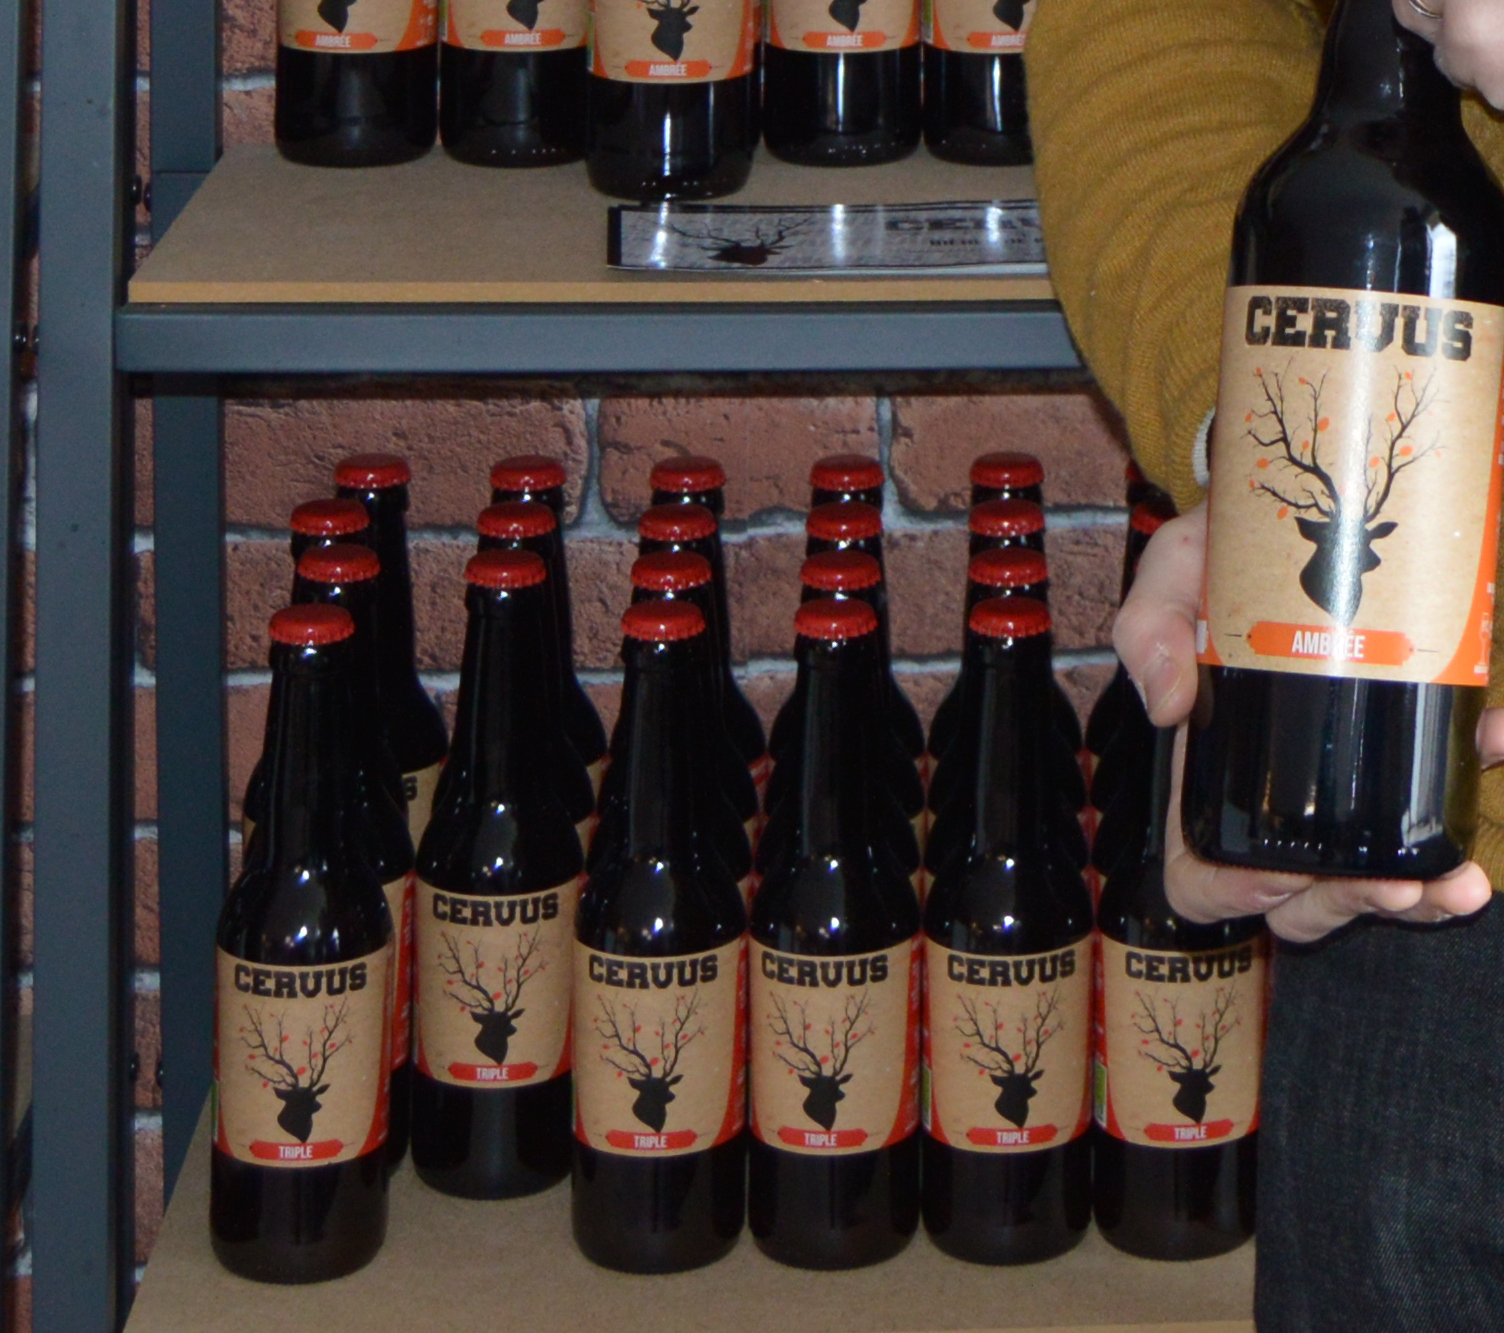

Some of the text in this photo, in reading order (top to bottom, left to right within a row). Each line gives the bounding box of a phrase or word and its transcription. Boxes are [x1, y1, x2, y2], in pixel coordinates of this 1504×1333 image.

[1244, 295, 1474, 362] CERVUS
[432, 891, 559, 928] CERVUS
[234, 962, 368, 999] CERVUS
[588, 952, 719, 990] CERVUS
[761, 950, 889, 989] CERVUS
[946, 950, 1077, 988] CERVUS
[1124, 946, 1253, 985] CERVUS
[475, 1065, 509, 1081] TRIPLE
[633, 1132, 668, 1149] TRIPLE
[803, 1130, 838, 1147] TRIPLE
[996, 1129, 1030, 1145] TRIPLE
[1173, 1123, 1207, 1141] TRIPLE
[277, 1143, 314, 1160] TRIPLE
